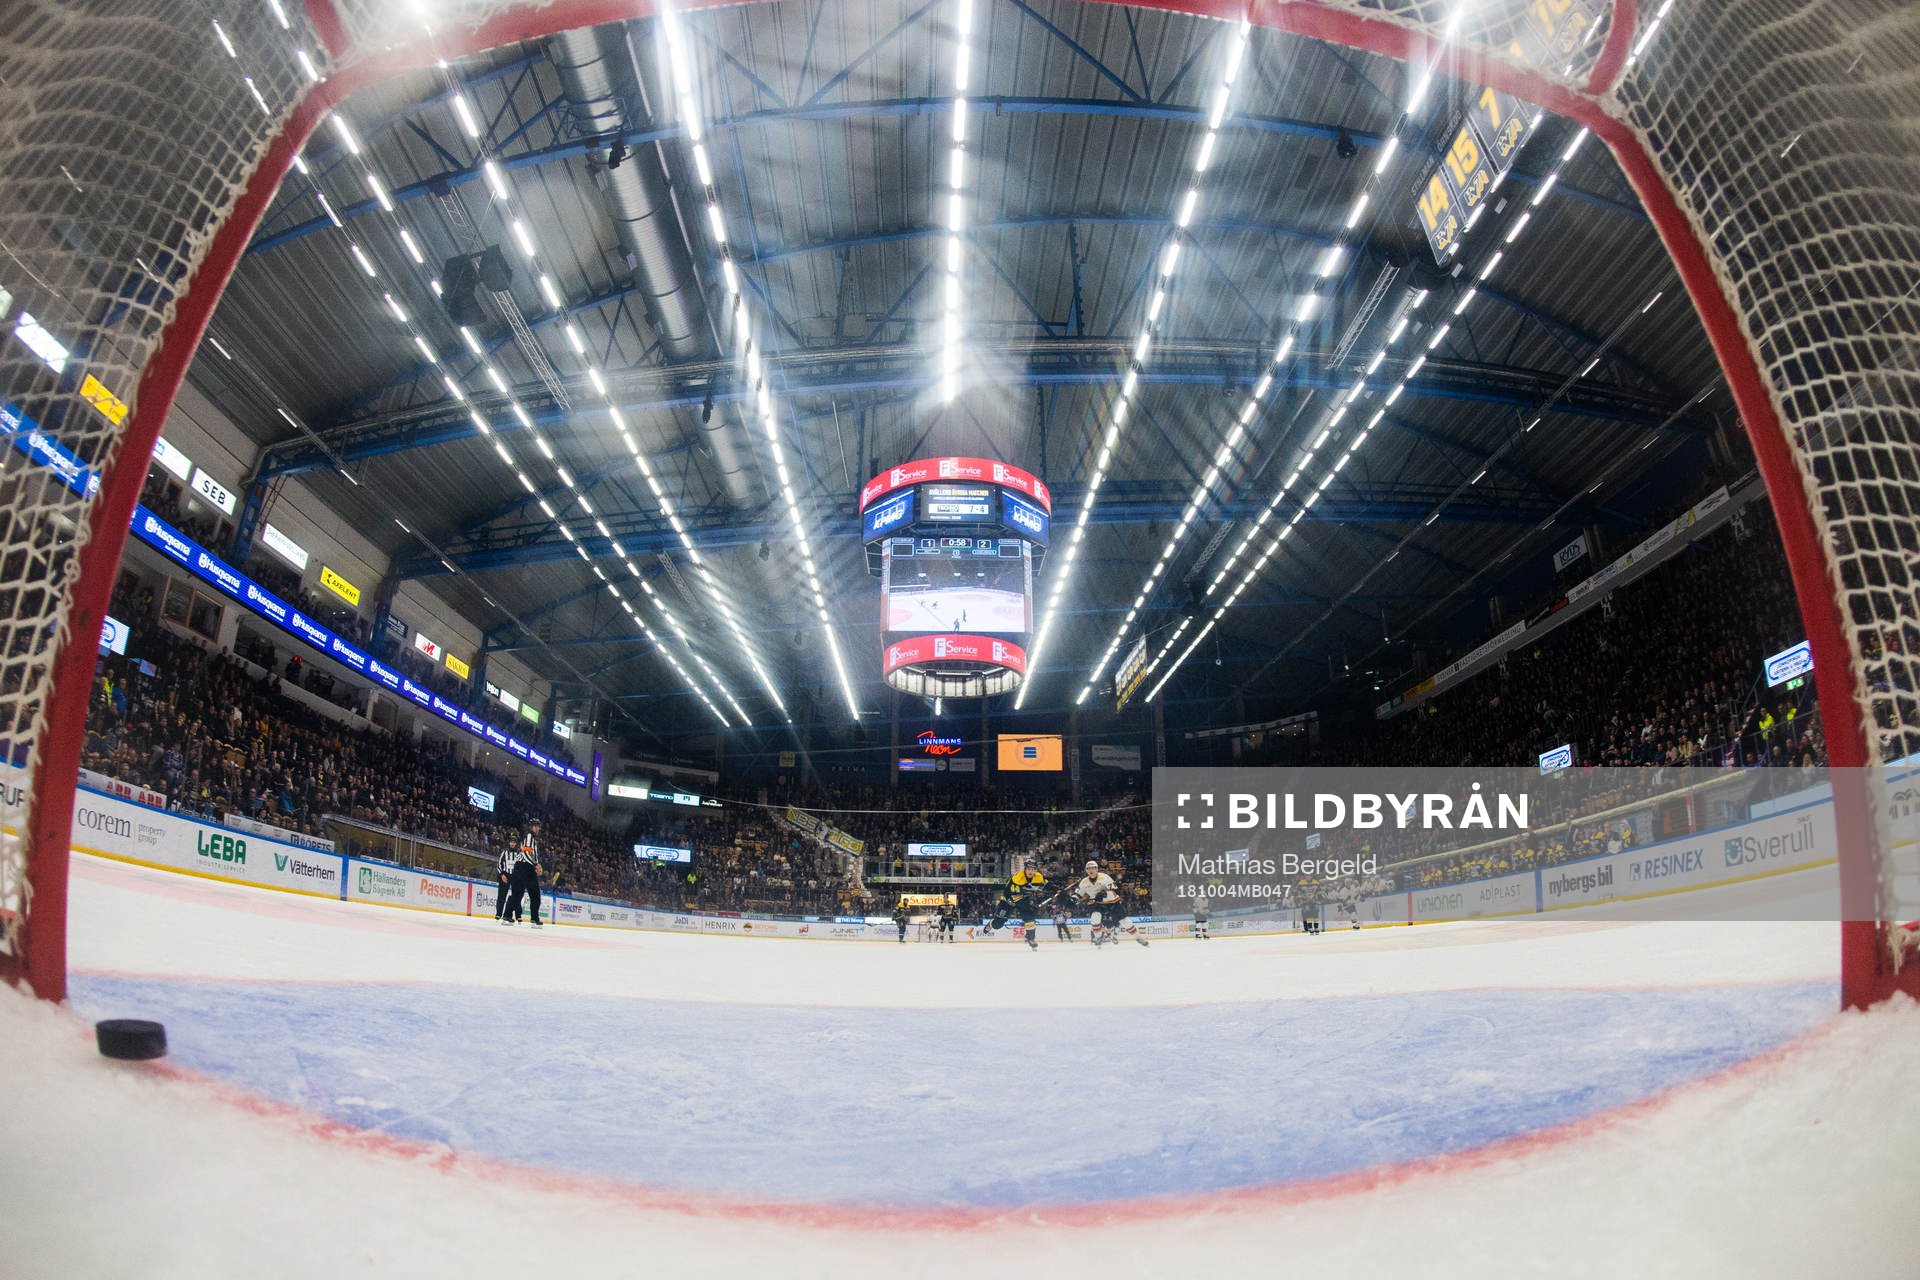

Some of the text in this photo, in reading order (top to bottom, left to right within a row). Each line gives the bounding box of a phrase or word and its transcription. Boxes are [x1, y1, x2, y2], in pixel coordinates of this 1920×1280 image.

[1478, 87, 1501, 130] 7
[1445, 127, 1479, 187] 15
[1418, 175, 1449, 232] 14
[202, 480, 226, 505] SEB
[873, 509, 904, 529] KPMG
[1013, 511, 1042, 532] KPMG
[946, 640, 978, 654] Service
[77, 807, 132, 838] corem
[138, 824, 166, 838] property
[138, 834, 158, 846] group
[197, 830, 247, 864] LEBA
[1744, 822, 1814, 862] Sverull
[290, 859, 335, 881] Vätterhem
[1644, 848, 1704, 880] RESINEX
[419, 878, 462, 900] Passera
[1548, 864, 1613, 898] nybergs bil
[705, 920, 736, 931] HENRIX
